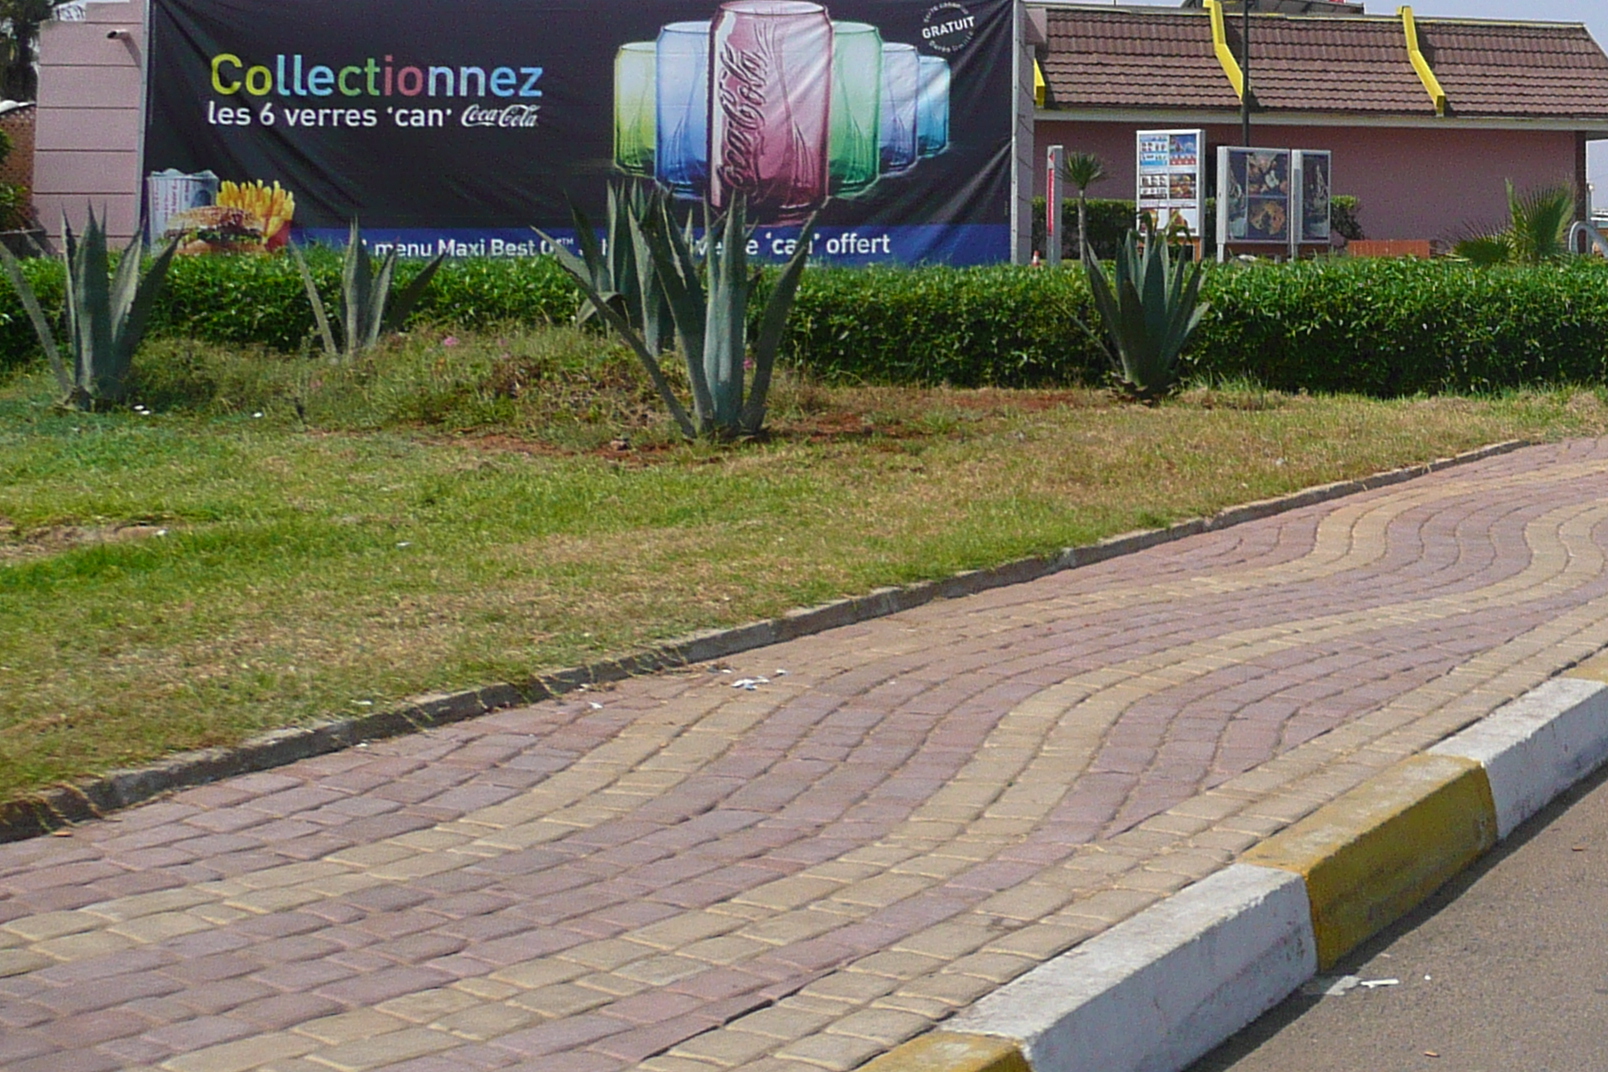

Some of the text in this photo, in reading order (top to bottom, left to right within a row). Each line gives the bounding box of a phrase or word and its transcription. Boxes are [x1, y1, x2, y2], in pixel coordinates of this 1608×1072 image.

[922, 16, 975, 39] GRATUIT
[211, 53, 543, 97] Collectionnez
[208, 101, 251, 125] les
[259, 102, 275, 126] 6
[284, 107, 377, 127] verres
[461, 103, 540, 128] Coca-Cola
[716, 41, 768, 189] Coca-Cola
[375, 242, 432, 257] menu
[438, 238, 485, 257] Maxi
[491, 238, 535, 256] Best
[826, 232, 891, 255] offert
